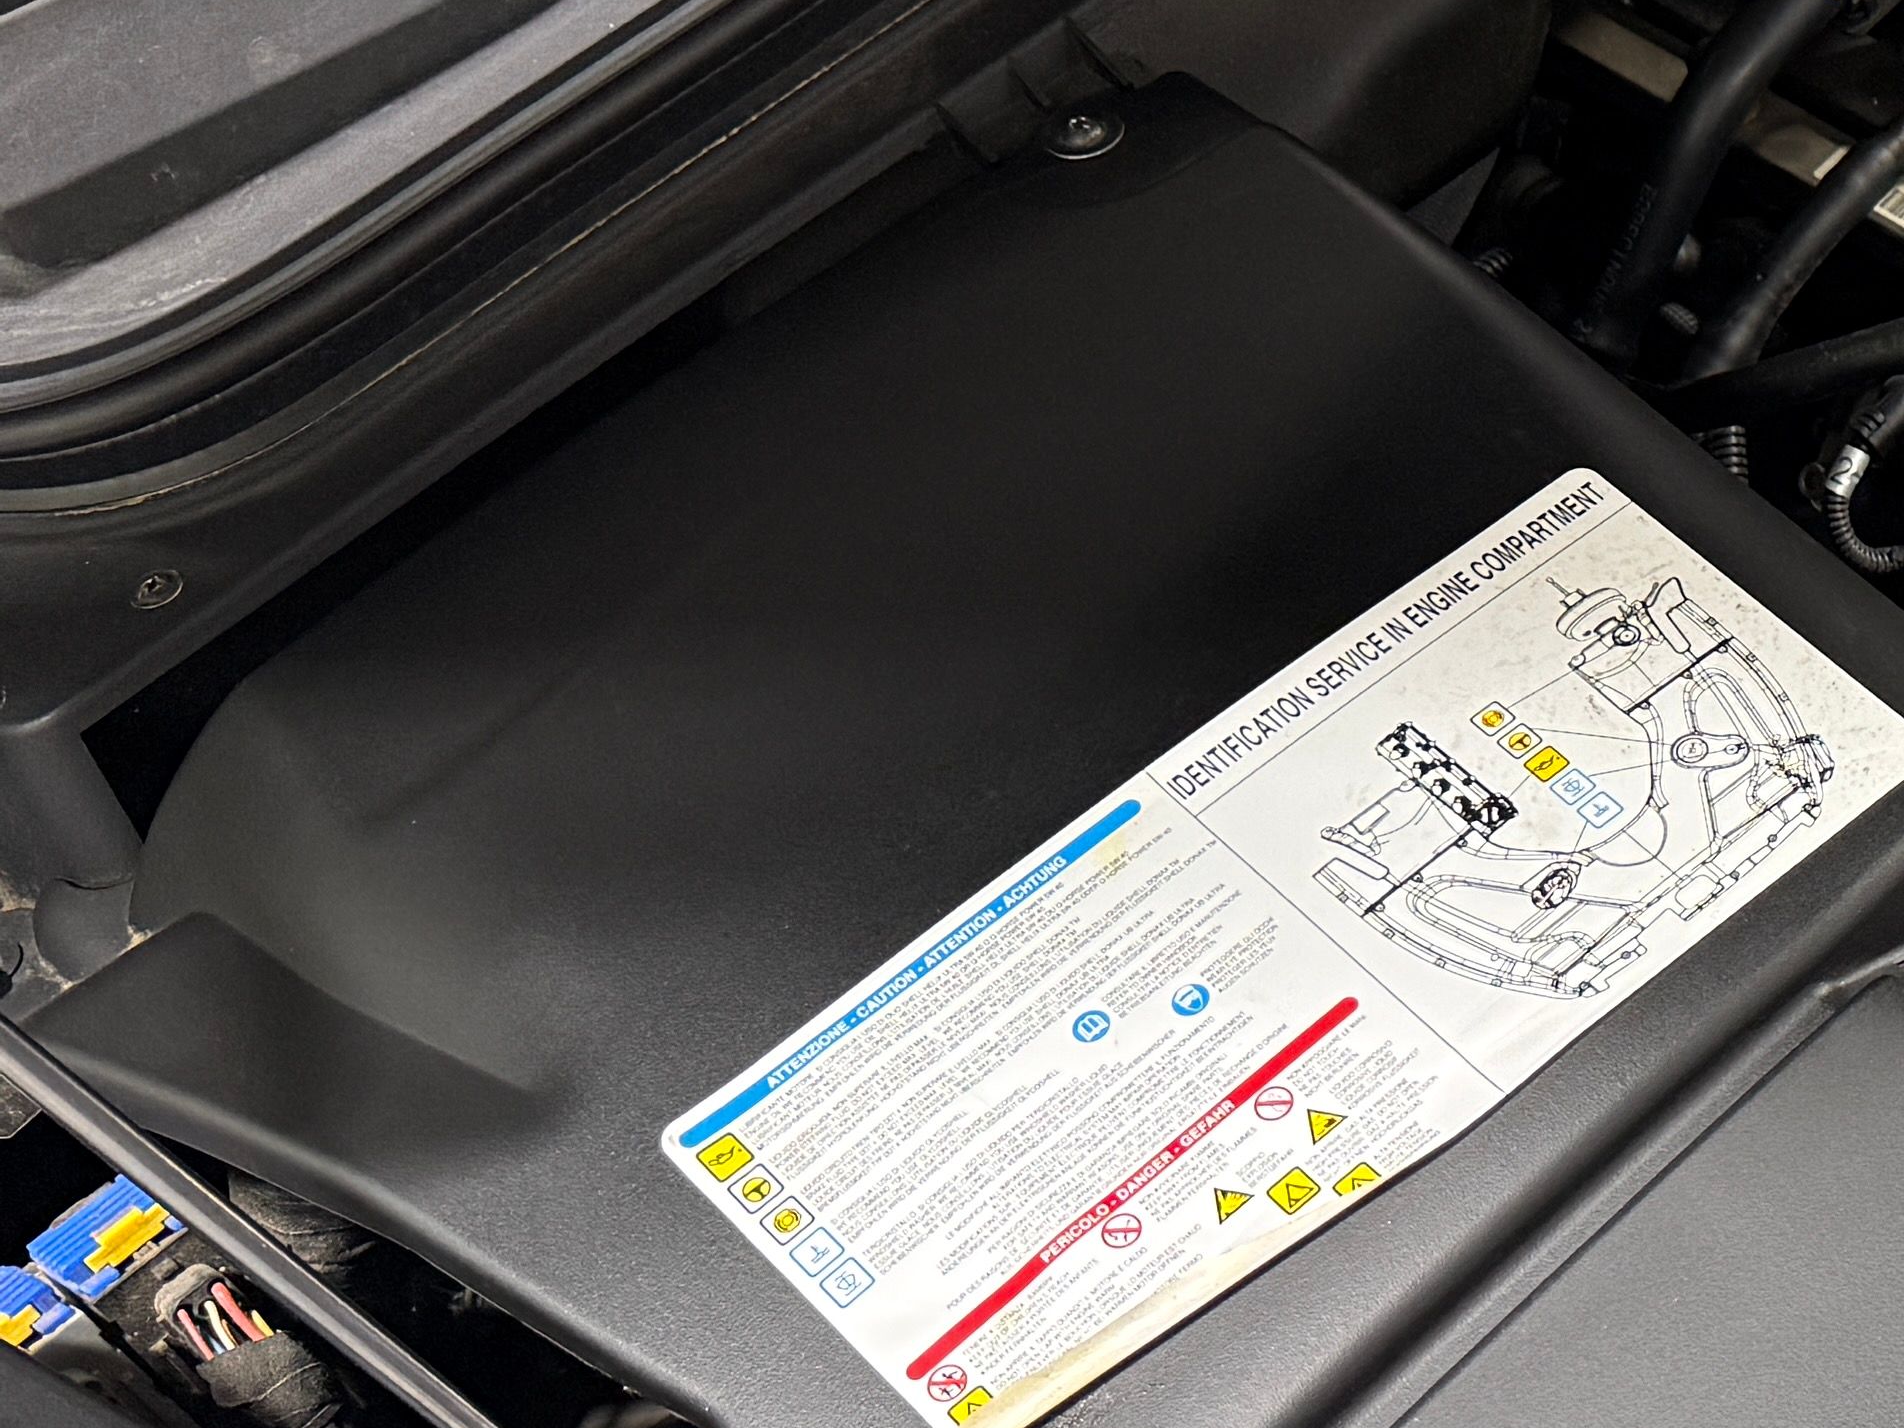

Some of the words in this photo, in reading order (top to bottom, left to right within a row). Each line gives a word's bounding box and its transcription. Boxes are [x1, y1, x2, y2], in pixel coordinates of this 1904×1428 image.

[1831, 456, 1853, 485] 2
[1164, 685, 1317, 800] IDENTIFICATION
[1303, 630, 1393, 699] SERVICE
[1379, 616, 1414, 644] IN
[1401, 568, 1480, 629] ENGINE
[1467, 480, 1608, 582] COMPARTMENT
[762, 1019, 853, 1089] ATTENZIONE
[852, 967, 920, 1019] CAUTION
[919, 908, 999, 969] ATTENTION
[998, 854, 1069, 908] ACHTUNG
[1037, 1200, 1112, 1264] PERICOLO
[1112, 1148, 1177, 1202] DANGER
[1175, 1097, 1236, 1148] GEFAHR
